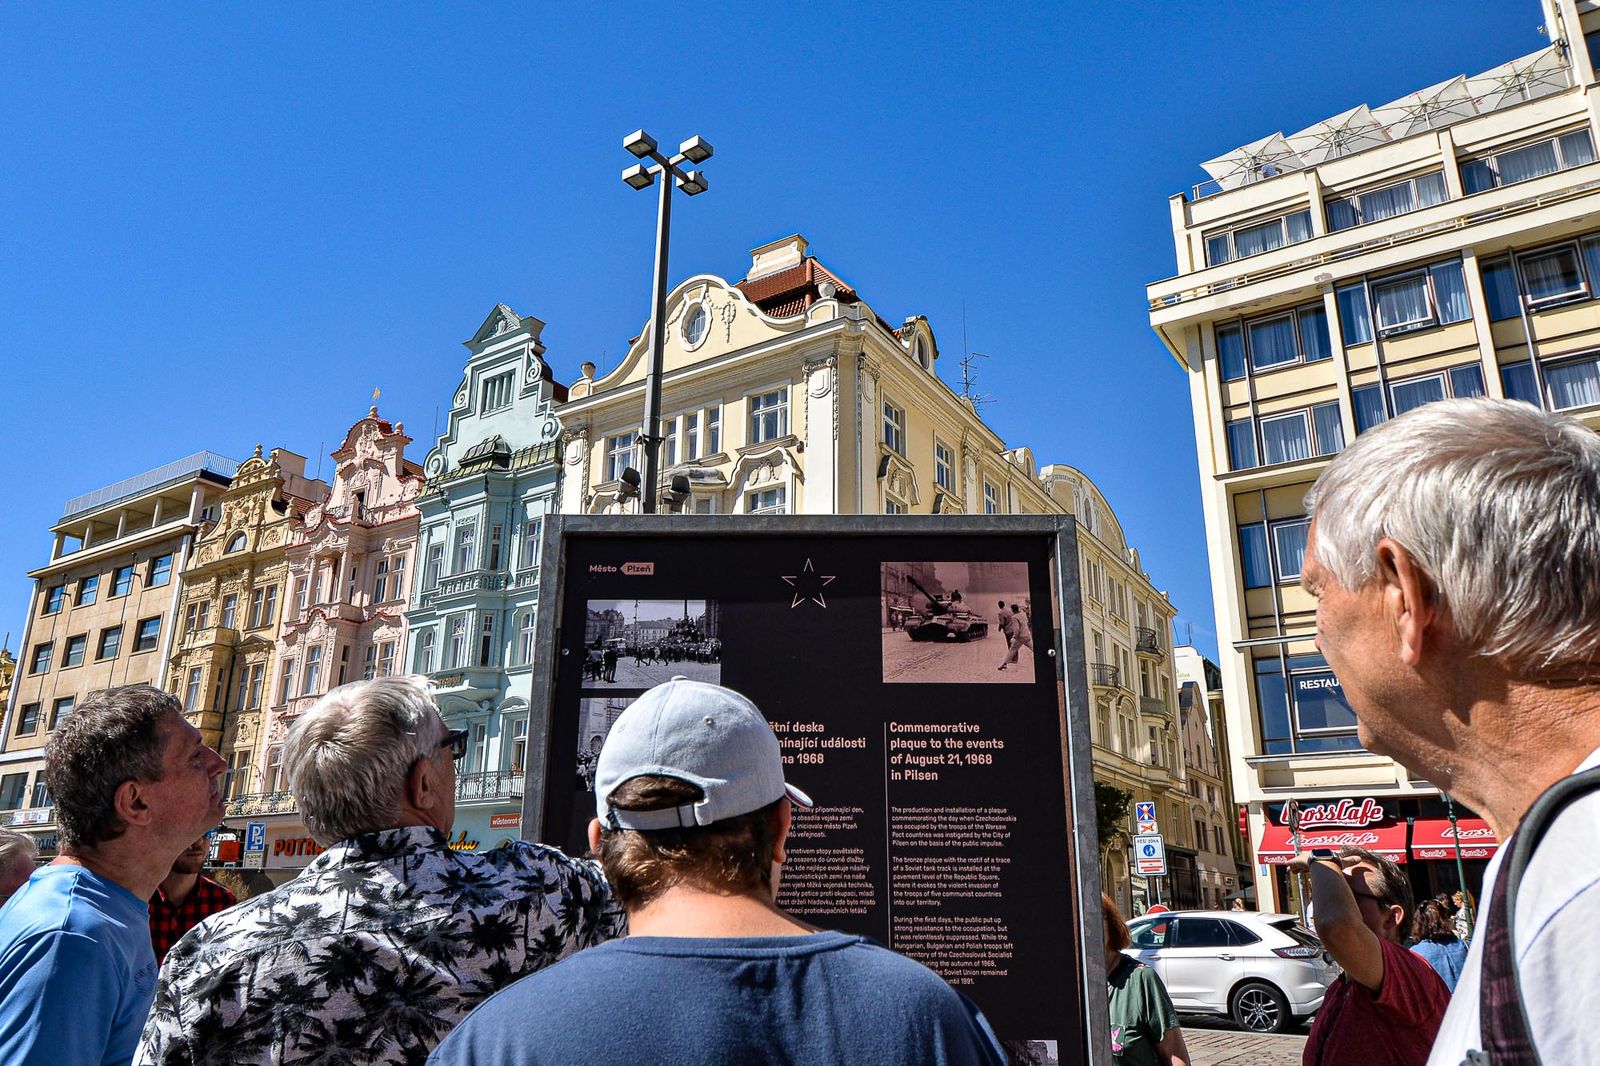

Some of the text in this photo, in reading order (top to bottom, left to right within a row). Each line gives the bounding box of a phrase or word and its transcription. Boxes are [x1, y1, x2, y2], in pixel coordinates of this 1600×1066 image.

[589, 563, 617, 573] Město
[626, 564, 651, 573] Plzeň
[1299, 678, 1342, 690] RESTAU
[769, 722, 825, 733] ětní deska
[890, 722, 980, 733] Commemorative
[820, 737, 867, 748] události
[890, 737, 1004, 751] plaque to the events
[781, 753, 824, 764] na 1968
[890, 754, 992, 767] of August 21, 1968
[891, 770, 938, 781] in Pilsen
[902, 807, 933, 815] production
[988, 807, 1007, 815] plaque
[492, 817, 518, 826] wüstenrot
[892, 816, 937, 824] commemorating
[948, 816, 958, 824] day
[904, 824, 930, 832] occupied
[948, 824, 967, 832] troops
[944, 832, 974, 840] instigated
[992, 832, 1004, 840] City
[962, 840, 979, 848] public
[980, 840, 1003, 848] impulse.
[924, 857, 943, 865] plaque
[892, 874, 921, 882] pavement
[954, 874, 978, 882] Republic
[978, 874, 1000, 882] Square,
[904, 891, 923, 899] troops
[916, 900, 941, 908] territory.
[894, 916, 913, 924] During
[937, 917, 953, 925] days,
[964, 917, 982, 925] public
[982, 917, 993, 925] put
[894, 926, 913, 934] strong
[962, 926, 996, 934] occupation,
[912, 934, 945, 942] relentlessly
[946, 934, 980, 942] suppressed.
[894, 943, 925, 951] Hungarian,
[926, 942, 954, 950] Bulgarian
[983, 943, 1002, 951] troops
[905, 951, 930, 959] territory
